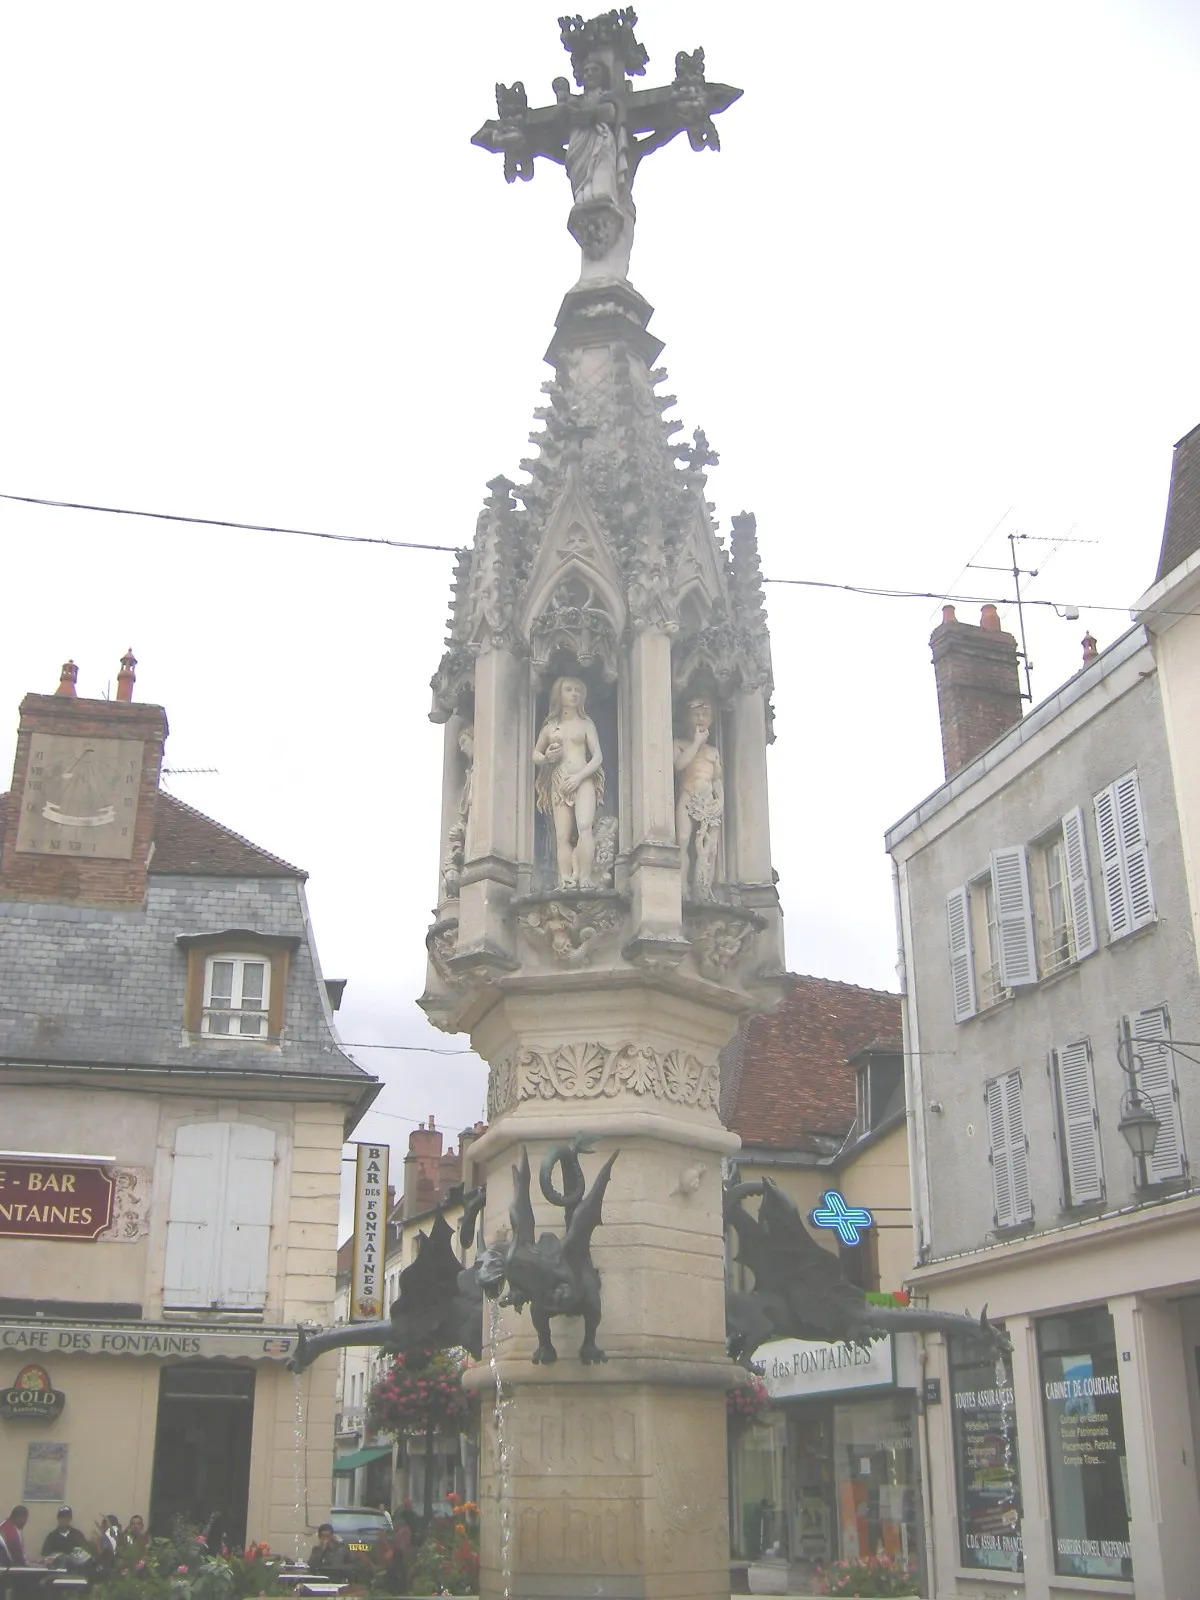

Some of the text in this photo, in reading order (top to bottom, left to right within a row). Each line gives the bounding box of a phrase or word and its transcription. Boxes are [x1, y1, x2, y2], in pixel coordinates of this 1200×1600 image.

[366, 1148, 381, 1184] BAR
[28, 1172, 76, 1193] BAR
[365, 1188, 380, 1196] DES
[364, 1201, 378, 1296] FONTAINES
[3, 1330, 200, 1352] CAFE DES FONTAINES
[772, 1356, 790, 1378] des
[793, 1344, 871, 1376] FONTAINES
[7, 1390, 56, 1405] GOLD
[1045, 1376, 1119, 1400] CABINET DE COURTAGE
[955, 1392, 976, 1408] TOUTES
